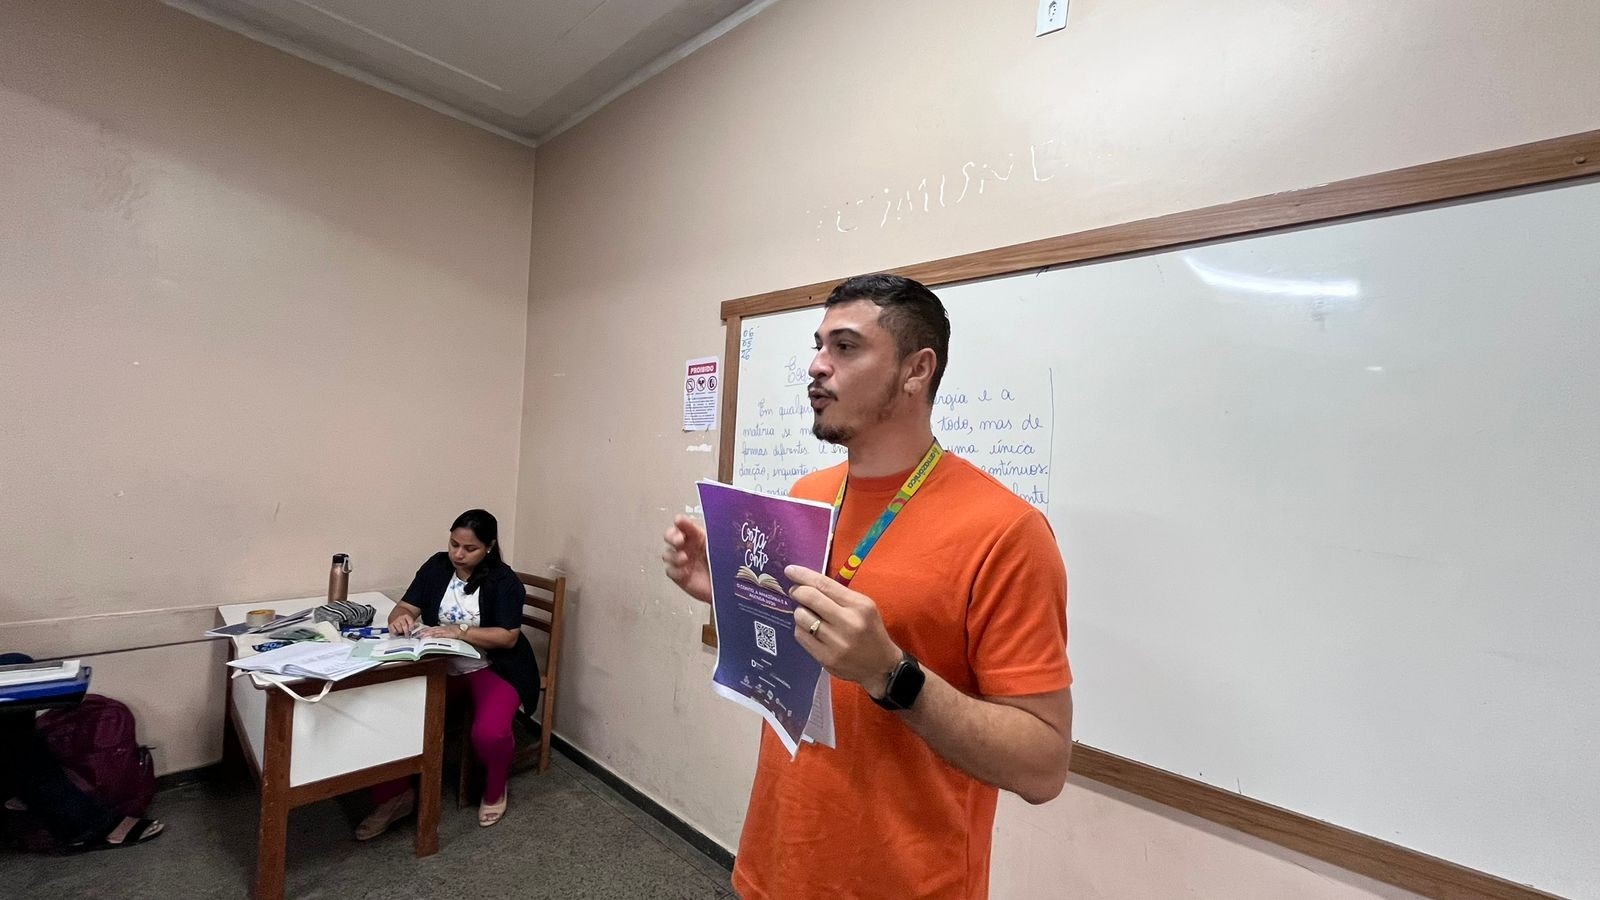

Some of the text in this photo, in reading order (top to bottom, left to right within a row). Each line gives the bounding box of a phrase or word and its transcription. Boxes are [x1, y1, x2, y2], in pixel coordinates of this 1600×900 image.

[690, 364, 715, 374] PROIBIDO
[1000, 388, 1015, 401] a
[743, 422, 775, 437] matéria
[937, 416, 973, 435] todo,
[980, 419, 1012, 430] mas
[1022, 413, 1044, 430] de
[990, 440, 1035, 455] única
[745, 549, 769, 571] Conto
